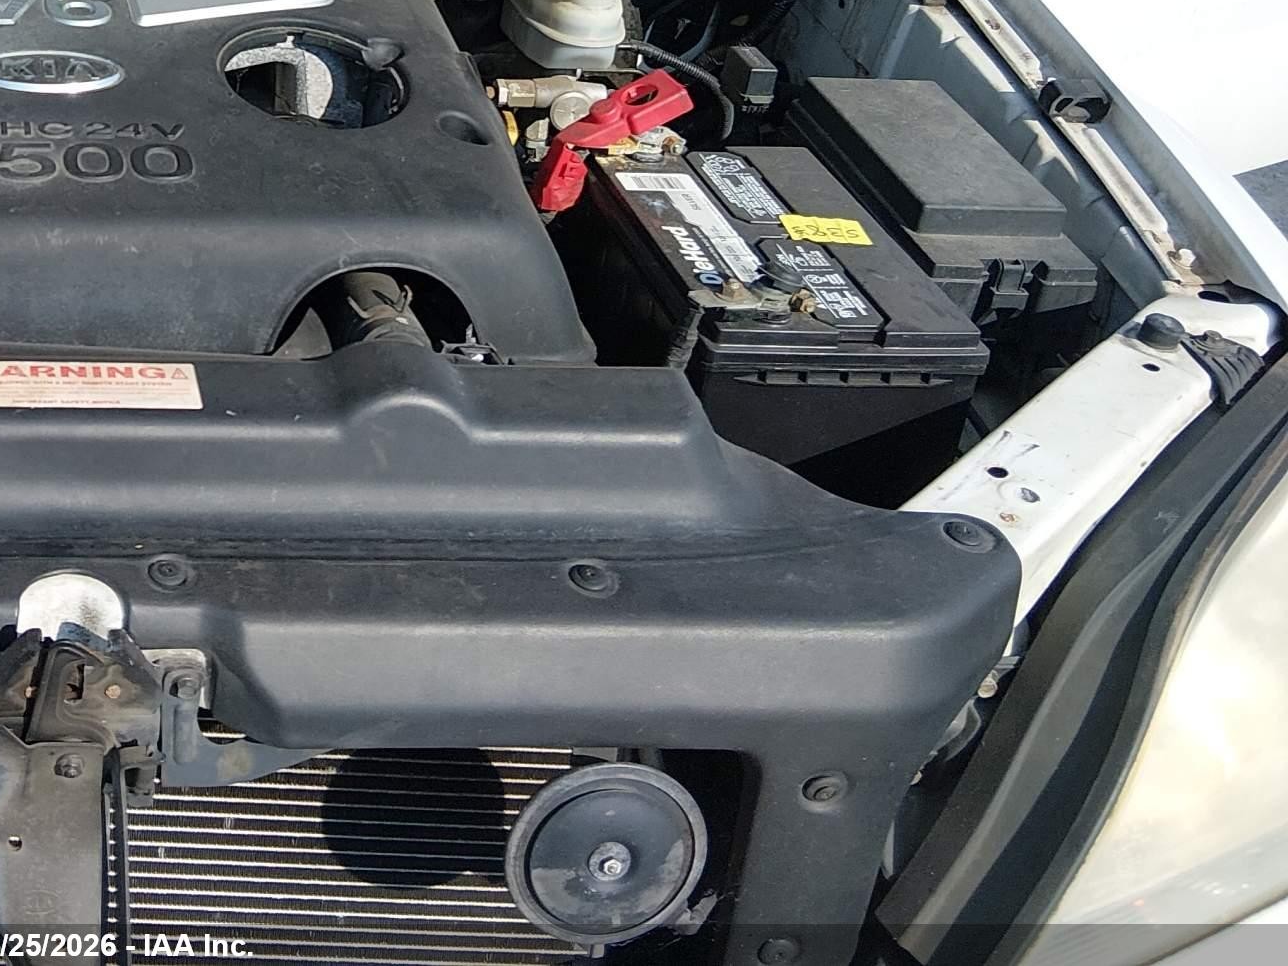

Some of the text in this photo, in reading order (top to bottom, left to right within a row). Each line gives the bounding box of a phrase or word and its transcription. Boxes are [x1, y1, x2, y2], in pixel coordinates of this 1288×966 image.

[0, 57, 100, 81] KIA
[83, 121, 185, 140] 24V
[661, 225, 724, 286] DieHard
